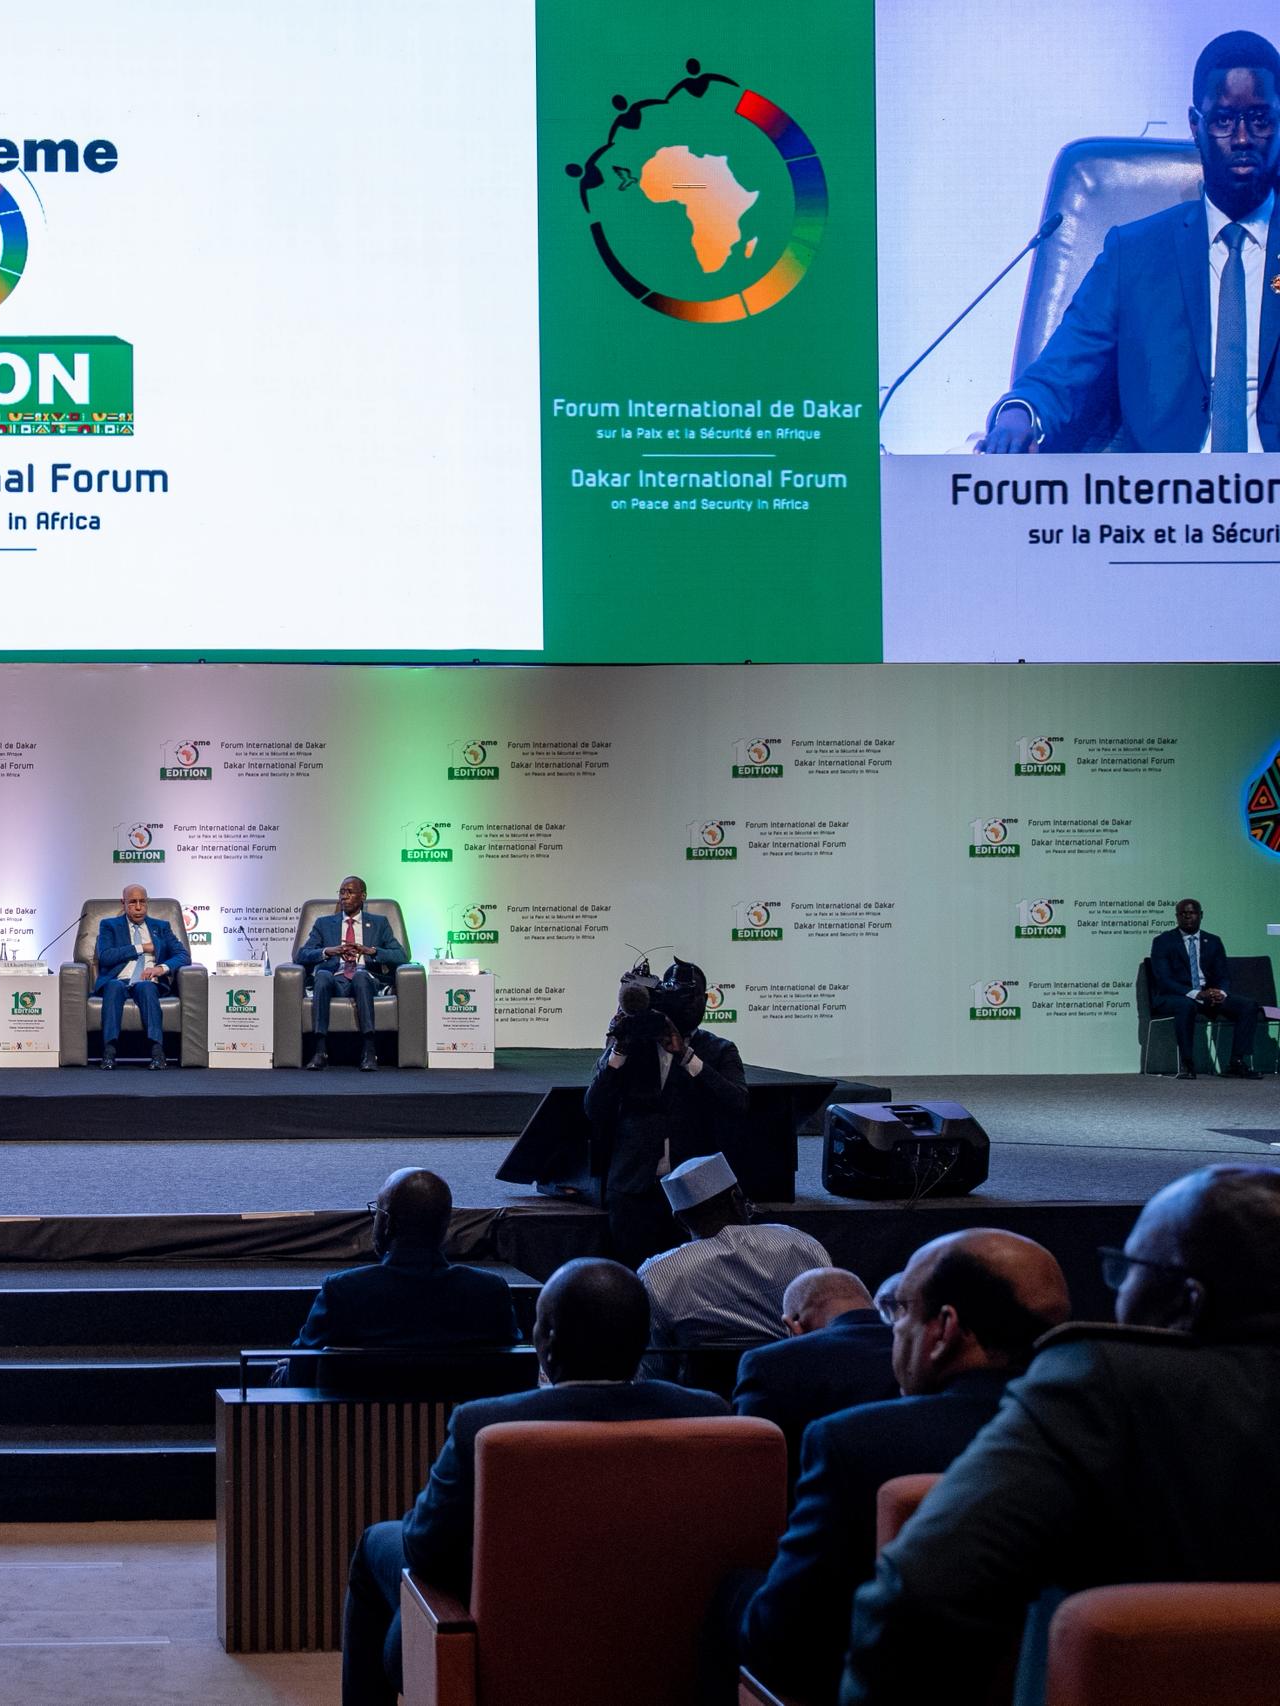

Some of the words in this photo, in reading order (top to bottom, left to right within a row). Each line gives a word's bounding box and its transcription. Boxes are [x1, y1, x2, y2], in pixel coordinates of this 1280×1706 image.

[553, 398, 620, 417] Forum
[628, 399, 761, 418] International
[770, 400, 794, 418] de
[803, 399, 863, 418] Dakar
[596, 429, 617, 439] sur
[621, 428, 633, 439] la
[636, 427, 663, 439] Paix
[667, 429, 681, 439] et
[684, 428, 696, 439] la
[700, 426, 752, 439] Sécurité
[756, 429, 771, 439] en
[776, 427, 821, 441] Afrique
[51, 463, 169, 493] Forum
[571, 468, 631, 488] Dakar
[639, 469, 772, 488] International
[780, 469, 847, 488] Forum
[951, 473, 1068, 506] Forum
[611, 500, 627, 510] on
[631, 497, 669, 510] Peace
[673, 498, 697, 510] and
[700, 498, 753, 512] Security
[758, 500, 769, 509] in
[772, 498, 809, 510] Africa
[8, 512, 27, 531] in
[36, 511, 101, 530] Africa
[1028, 528, 1064, 545] sur
[1072, 524, 1091, 544] la
[1099, 524, 1145, 544] Paix
[1154, 525, 1177, 544] et
[1185, 524, 1204, 544] la
[507, 741, 531, 749] Forum
[532, 741, 578, 749] International
[591, 741, 612, 749] Dakar
[510, 761, 532, 769] Dakar
[535, 761, 583, 769] International
[585, 761, 609, 769] Forum
[791, 902, 814, 910] Forum
[794, 922, 816, 930] Dakar
[1032, 1001, 1054, 1009] Dakar
[1056, 1000, 1104, 1009] International
[1106, 1000, 1130, 1008] Forum
